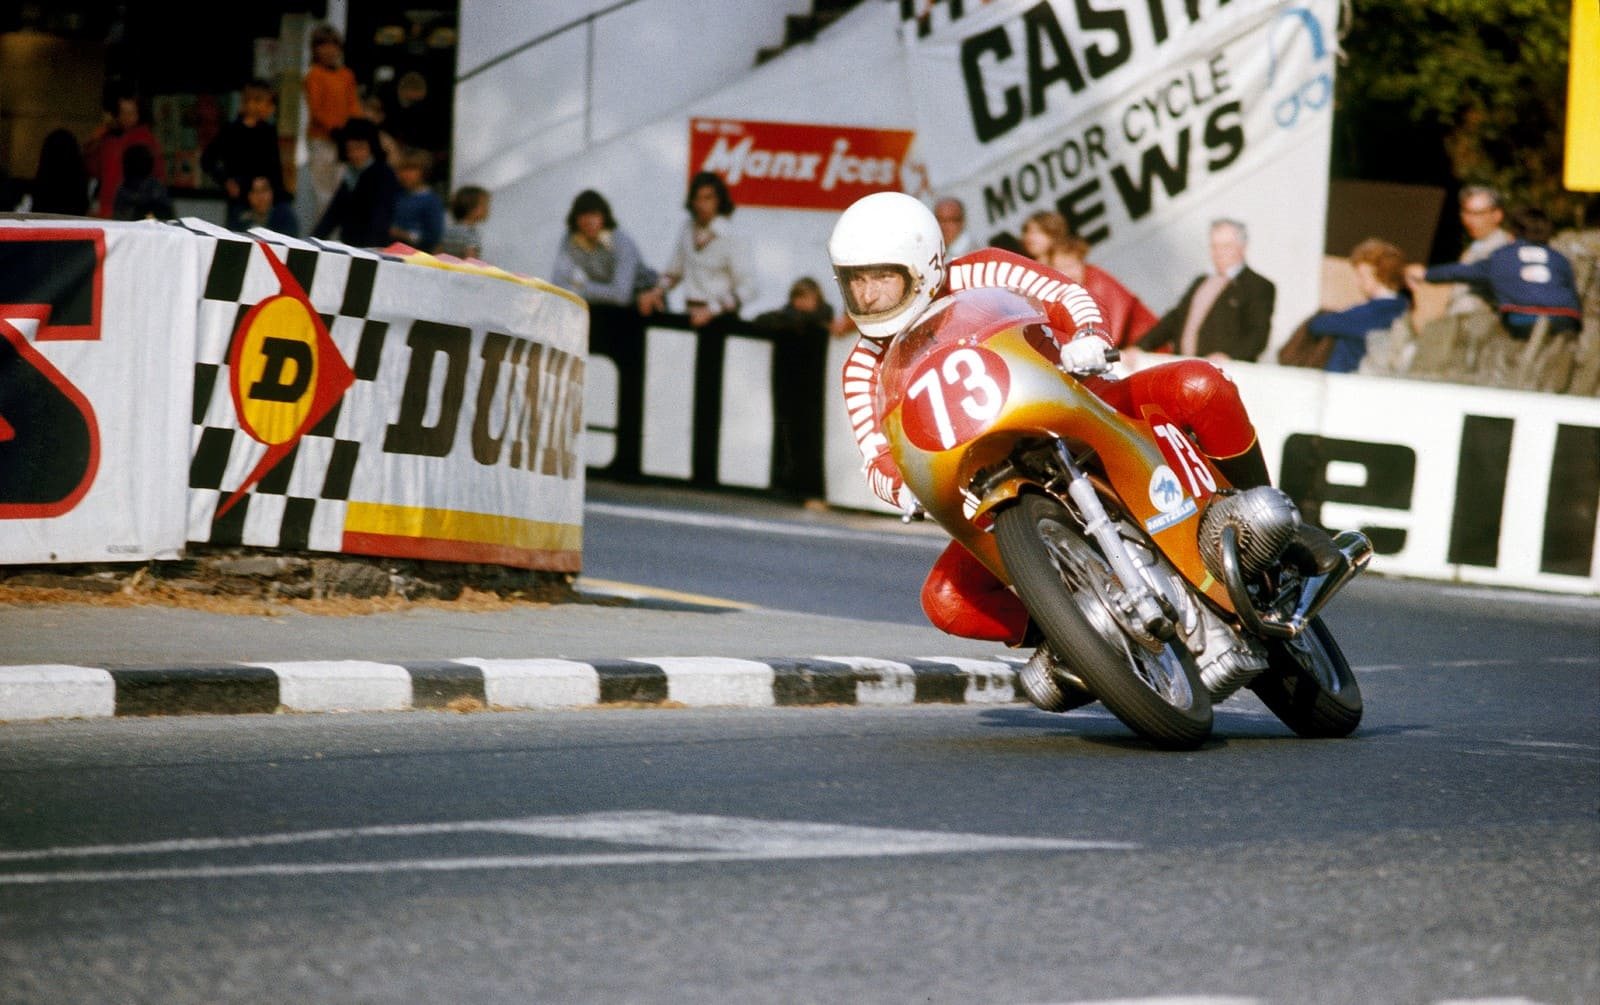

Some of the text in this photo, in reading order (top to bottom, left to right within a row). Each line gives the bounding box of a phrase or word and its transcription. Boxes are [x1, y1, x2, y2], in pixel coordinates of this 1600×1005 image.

[961, 0, 1236, 144] CAS
[703, 136, 822, 185] Manx
[983, 54, 1231, 223] MOTOR CYCLE
[907, 348, 1001, 450] 73
[1153, 422, 1217, 498] 73
